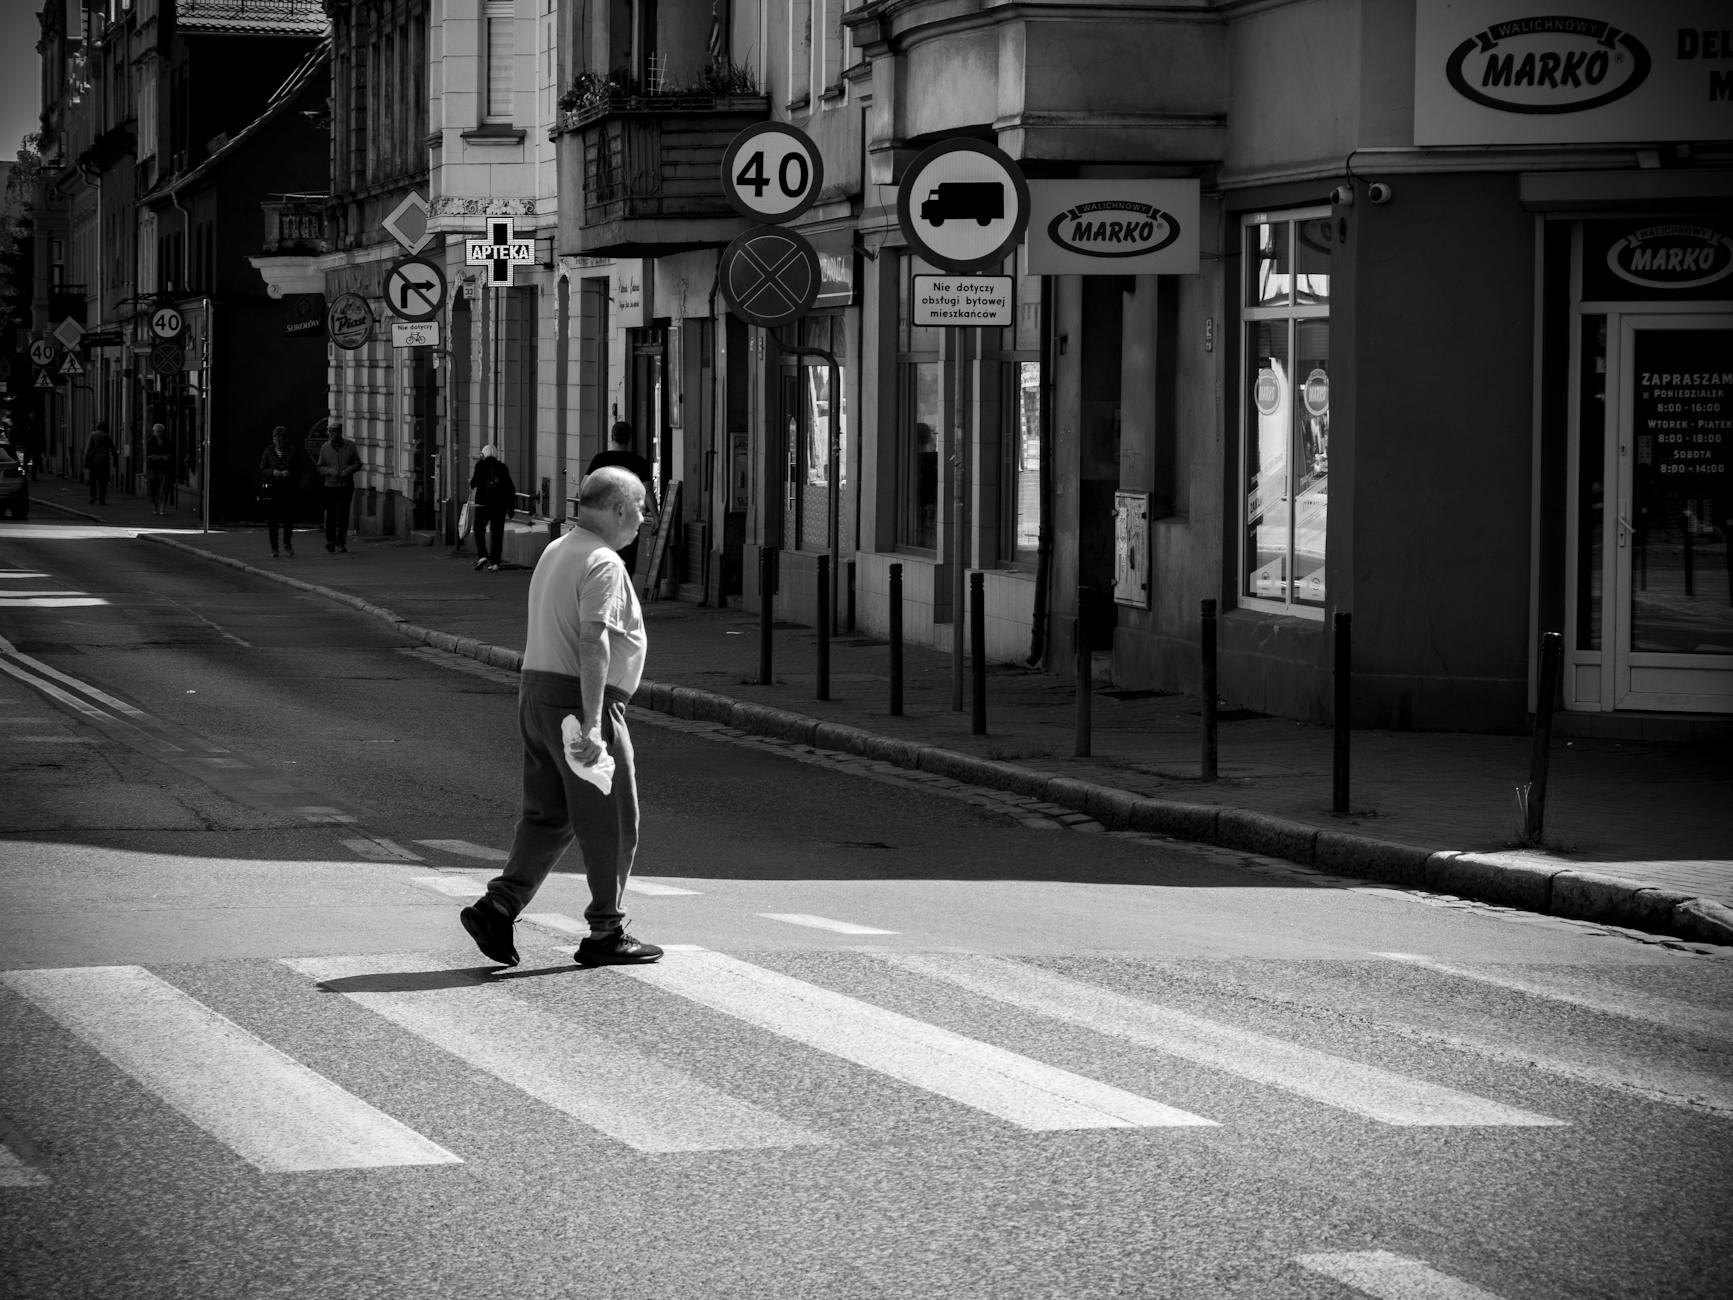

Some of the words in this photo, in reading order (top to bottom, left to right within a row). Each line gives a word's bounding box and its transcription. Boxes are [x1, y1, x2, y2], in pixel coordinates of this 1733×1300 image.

[1498, 18, 1600, 36] WALICHNOWY
[1481, 49, 1609, 89] MARKO
[736, 151, 809, 198] 40
[1081, 200, 1149, 213] WALICHNOWY
[1071, 221, 1154, 243] MARKO
[472, 244, 529, 260] APTEKA
[1630, 246, 1716, 272] MARKO
[933, 282, 951, 291] Nie
[956, 282, 995, 293] dotyczy
[921, 295, 960, 307] obsługi
[966, 296, 1006, 308] bytowej
[930, 308, 997, 318] mieszkańców
[155, 314, 180, 331] 40
[335, 315, 367, 332] Piast
[410, 323, 433, 332] dotyczy
[32, 345, 53, 359] 40
[1641, 372, 1733, 386] ZAPRASZAM
[1657, 403, 1682, 413] 8:00
[1691, 403, 1721, 413] 16:00
[1647, 420, 1688, 429] WTOREK
[1658, 434, 1683, 443] 8:00
[1692, 434, 1722, 443] 18:00
[1673, 450, 1712, 459] SOBOTA
[1660, 464, 1685, 473] 8:00
[1695, 464, 1725, 474] 14:00
